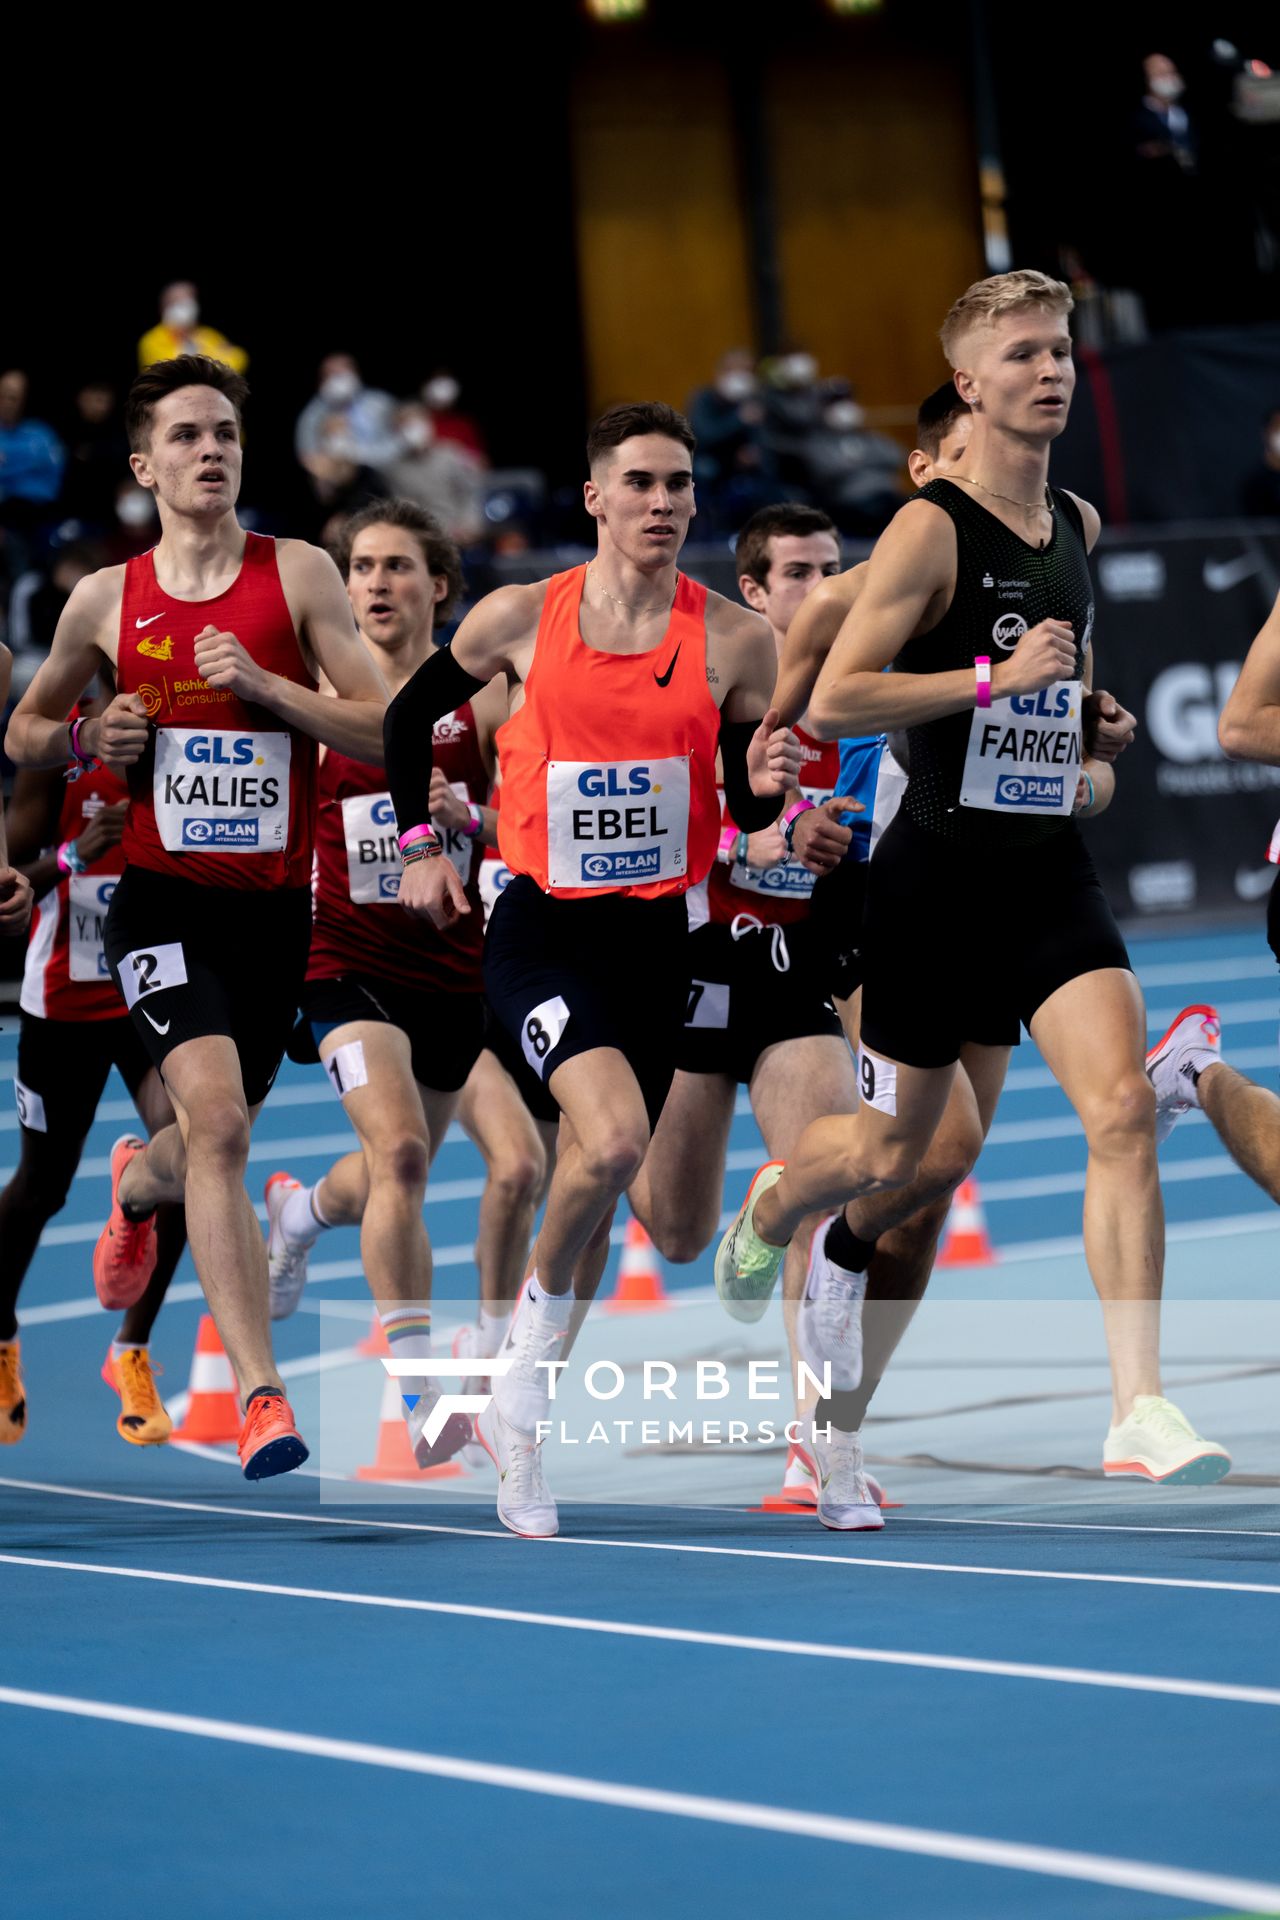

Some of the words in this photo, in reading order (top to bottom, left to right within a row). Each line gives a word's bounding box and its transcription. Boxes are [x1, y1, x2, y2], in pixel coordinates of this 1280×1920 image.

[176, 691, 236, 707] Consultan
[980, 724, 1080, 765] FARKEN
[165, 774, 279, 808] KALIES
[1027, 782, 1061, 796] PLAN
[214, 824, 256, 836] PLAN
[572, 806, 668, 840] EBEL
[615, 853, 658, 870] PLAN
[132, 953, 162, 995] 2
[686, 984, 705, 1024] 7
[527, 1017, 551, 1059] 8
[329, 1056, 345, 1095] 1
[861, 1054, 875, 1102] 9
